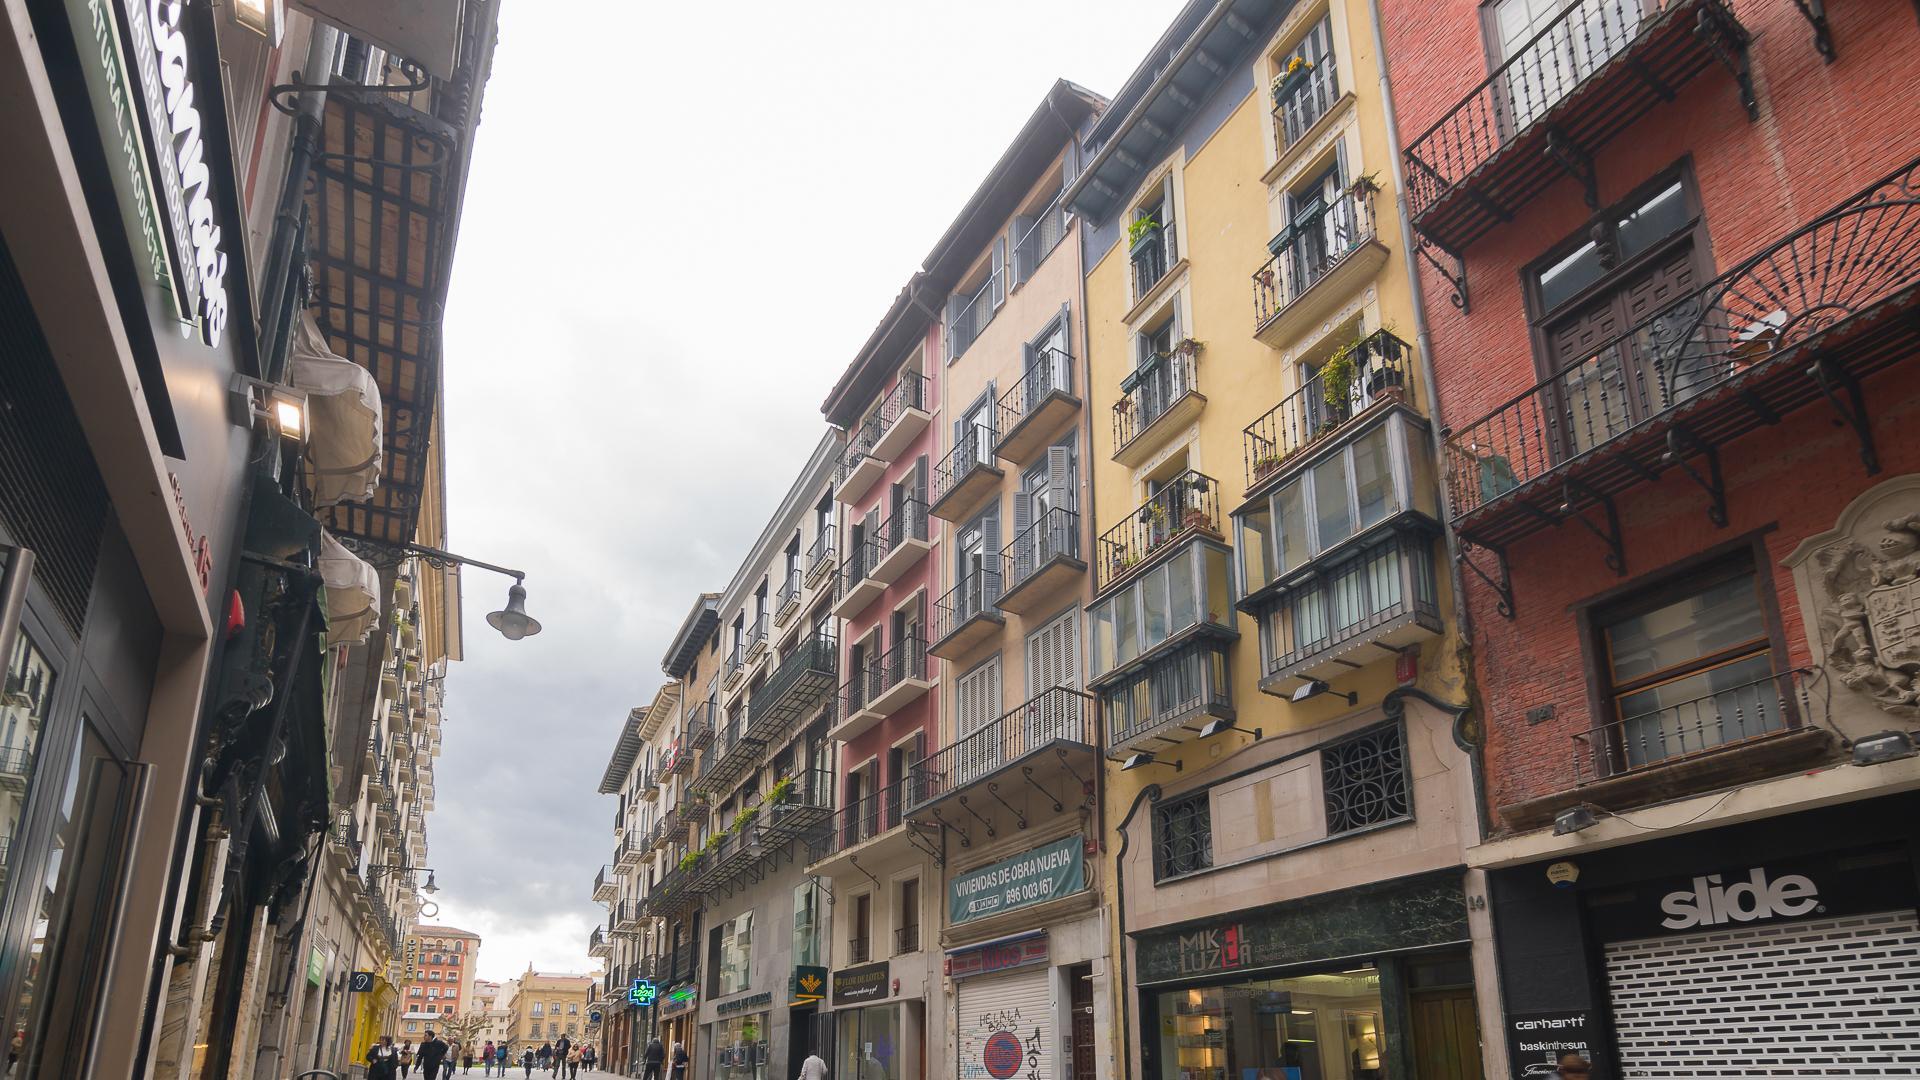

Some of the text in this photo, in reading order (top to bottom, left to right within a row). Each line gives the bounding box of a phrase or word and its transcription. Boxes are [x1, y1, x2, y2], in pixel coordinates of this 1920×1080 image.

[123, 130, 162, 281] PRODUCTS
[162, 144, 196, 293] PRODUCTS
[956, 848, 1071, 897] VIVIENDAS DE OBRA NUEVA
[1006, 877, 1053, 904] 696 003 167
[1515, 1016, 1585, 1030] carhartt
[1520, 1041, 1587, 1051] baskinthesun
